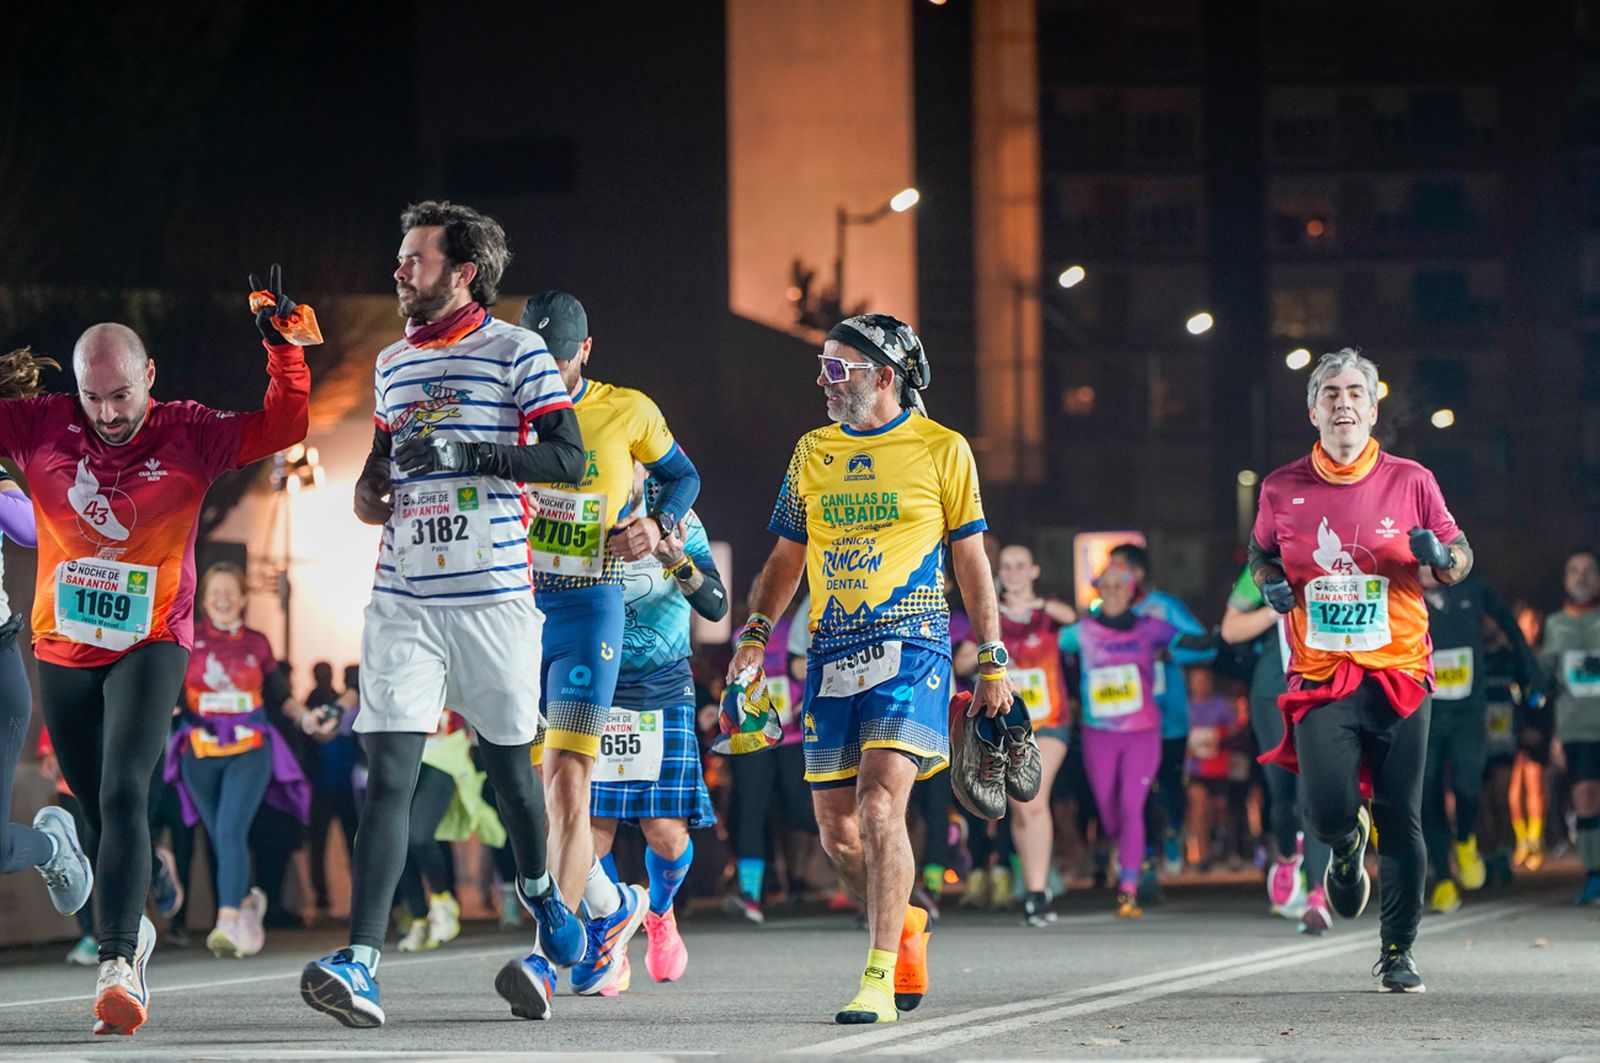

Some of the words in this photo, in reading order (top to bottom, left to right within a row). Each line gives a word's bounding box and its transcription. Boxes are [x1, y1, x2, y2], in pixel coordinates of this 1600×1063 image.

[438, 493, 449, 503] DE
[539, 498, 565, 509] NOCHE
[565, 502, 576, 511] DE
[821, 492, 878, 507] CANILLAS
[881, 492, 898, 505] DE
[82, 501, 109, 526] 43
[402, 507, 418, 518] SAN
[823, 505, 900, 523] ALBAIDA
[411, 514, 469, 546] 3182
[532, 517, 587, 548] 4705
[66, 575, 85, 586] SAN
[78, 566, 106, 580] NOCHE
[108, 571, 120, 581] DE
[826, 578, 869, 590] DENTAL
[1324, 584, 1347, 592] NOCHE
[1349, 584, 1359, 592] DE
[1314, 593, 1330, 601] SAN
[75, 589, 131, 621] 1169
[1318, 603, 1377, 626] 12227
[601, 734, 641, 756] 655
